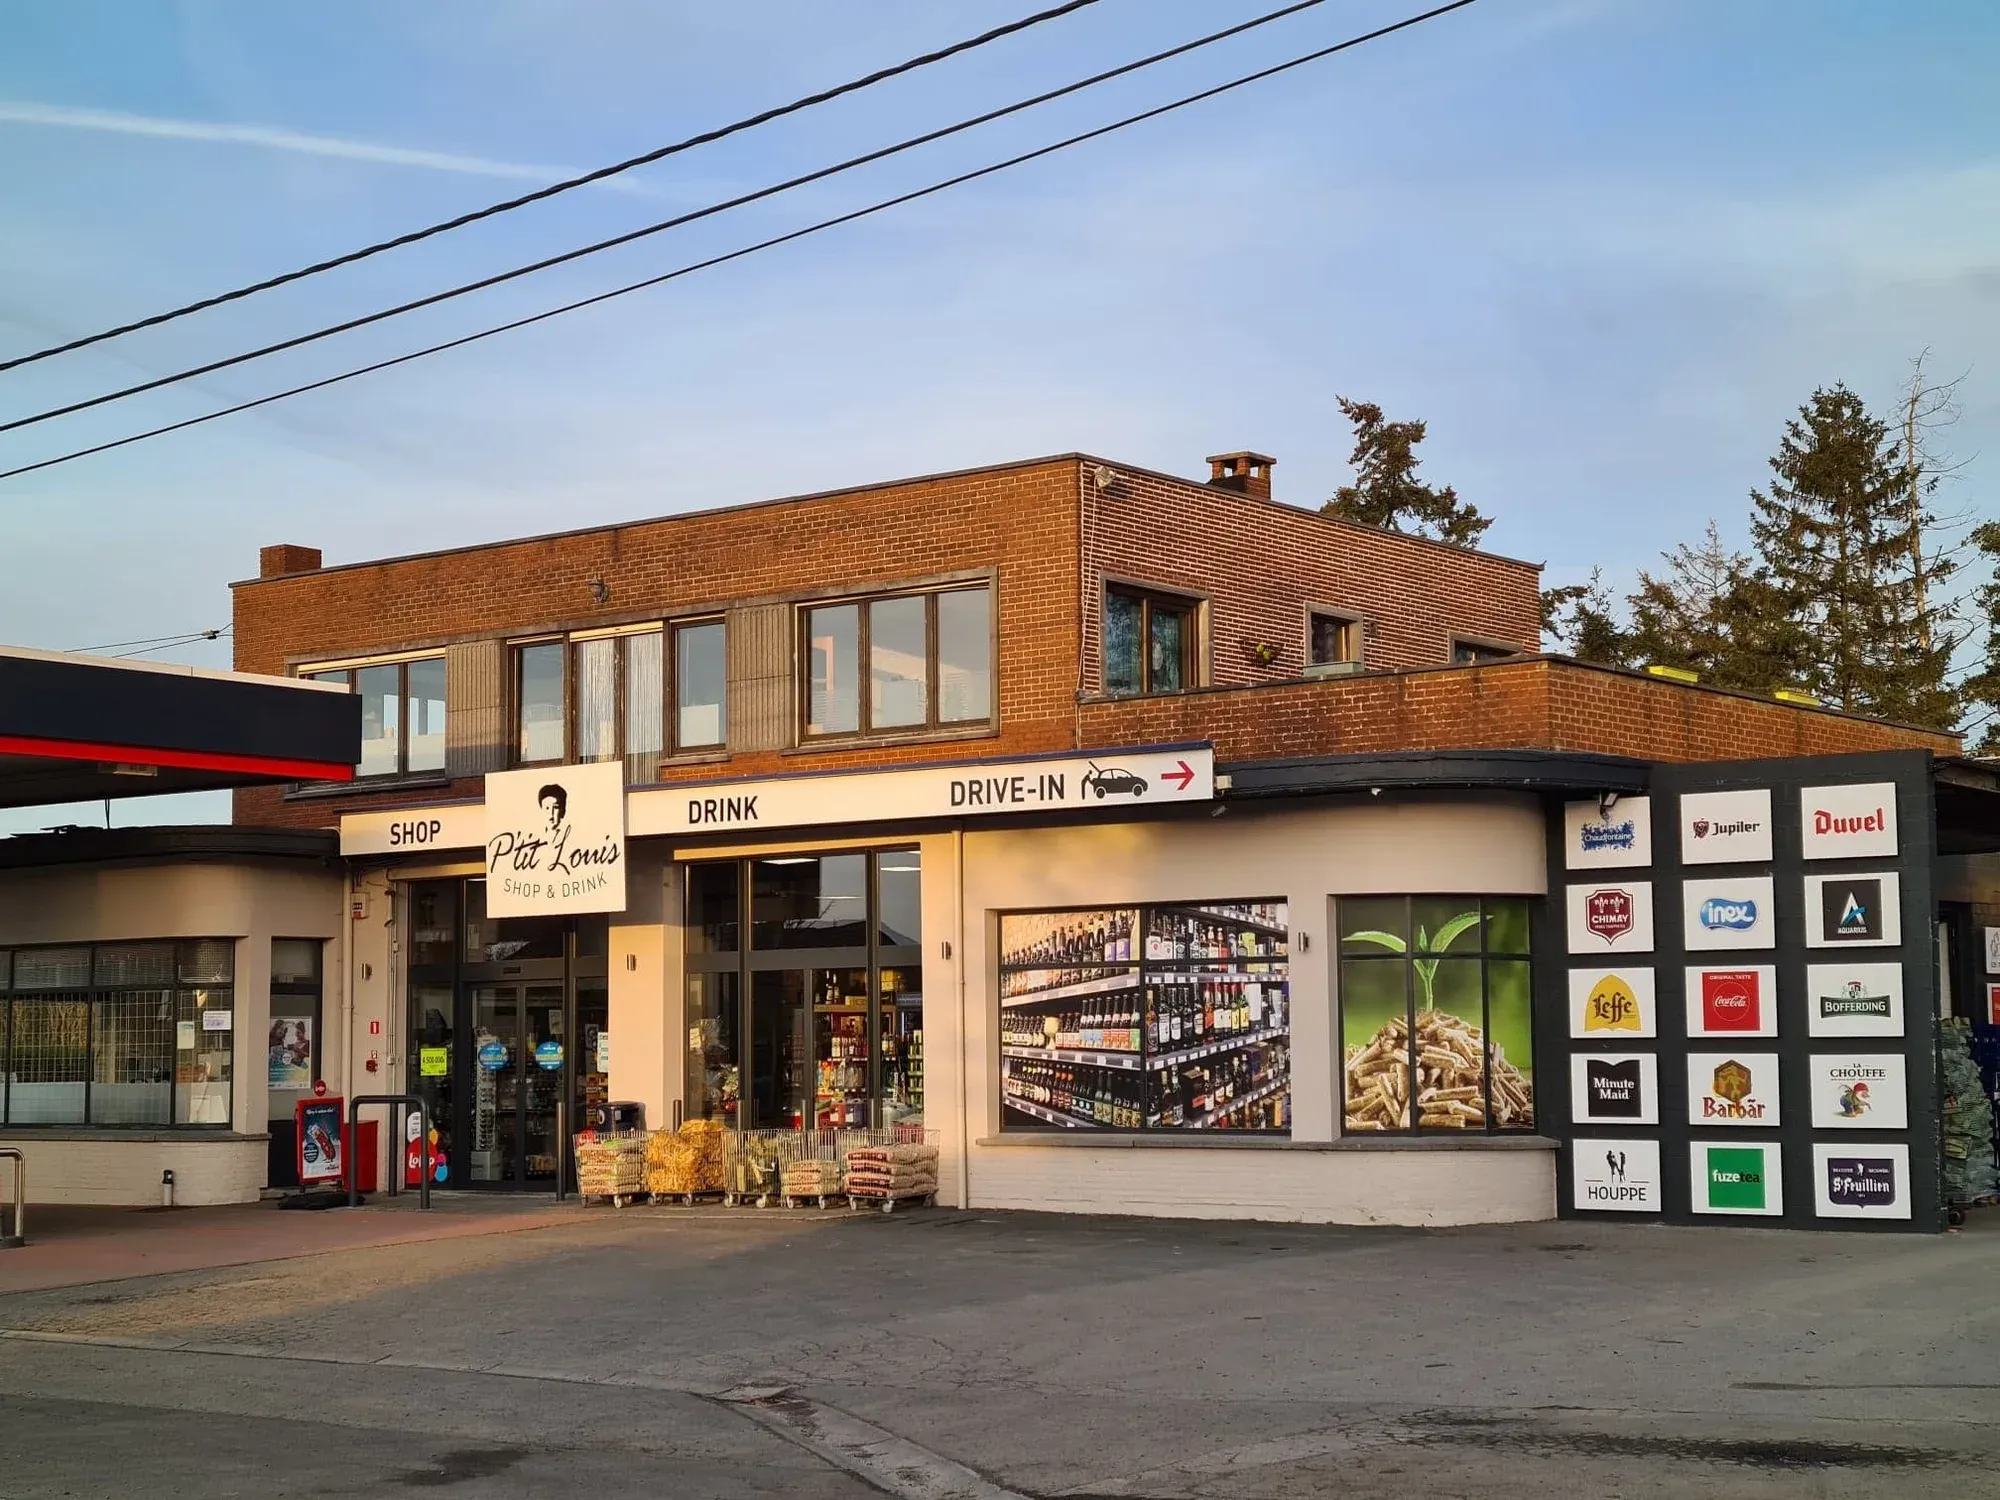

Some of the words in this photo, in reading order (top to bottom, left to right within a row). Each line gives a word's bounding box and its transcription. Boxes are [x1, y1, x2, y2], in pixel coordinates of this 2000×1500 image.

[951, 773, 1064, 806] DRIVE-IN
[689, 795, 758, 824] DRINK
[1712, 820, 1761, 836] Jupiler
[1814, 807, 1886, 835] Duvel
[389, 820, 441, 846] SHOP
[1584, 832, 1632, 843] Chaudfontaine
[547, 824, 621, 875] Louis
[503, 878, 541, 898] SHOP
[546, 884, 556, 899] &
[562, 871, 608, 898] DRINK
[1591, 914, 1629, 924] CHIMAY
[1708, 903, 1755, 924] inex
[1837, 926, 1867, 935] AQUARIUS
[1592, 991, 1632, 1024] Leffe
[1825, 1001, 1886, 1013] BOFFERDING
[1830, 1068, 1887, 1078] CHOUFFE
[1593, 1077, 1635, 1089] Minute
[1600, 1088, 1630, 1100] Maid
[1712, 1168, 1760, 1184] fuzetea
[1588, 1186, 1648, 1201] HOUPPE
